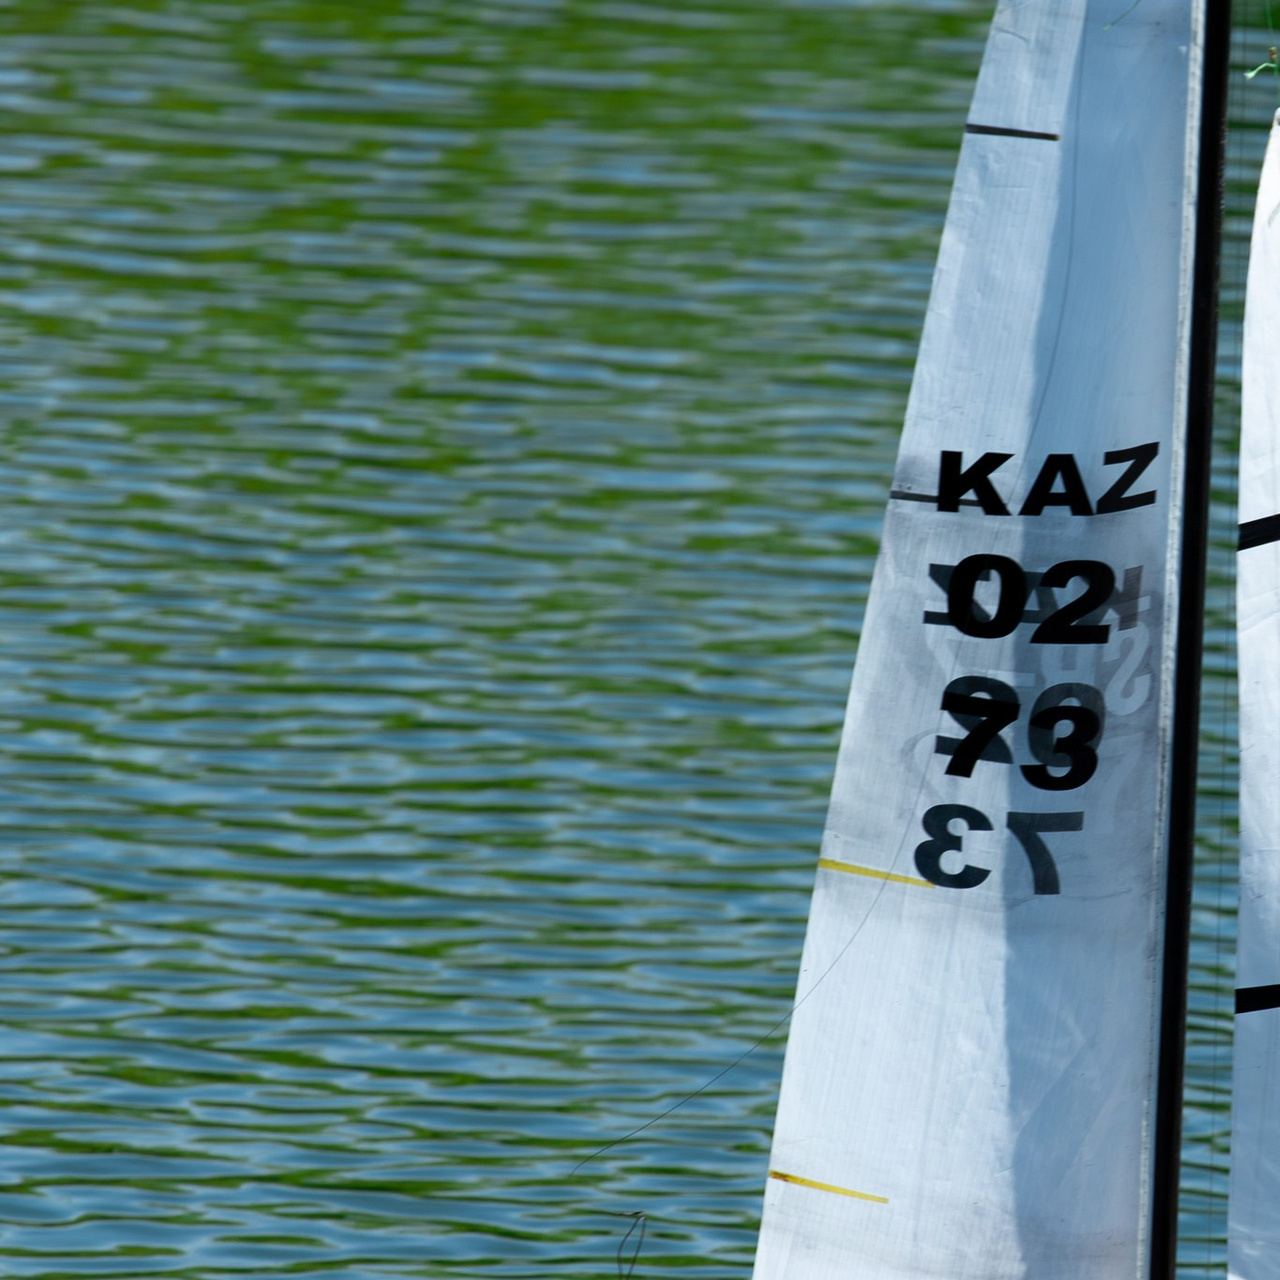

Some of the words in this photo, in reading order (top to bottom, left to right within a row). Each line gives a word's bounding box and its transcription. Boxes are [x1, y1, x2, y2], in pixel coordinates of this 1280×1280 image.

[937, 442, 1160, 516] KAZ
[948, 554, 1116, 645] 02
[940, 704, 1098, 791] 73
